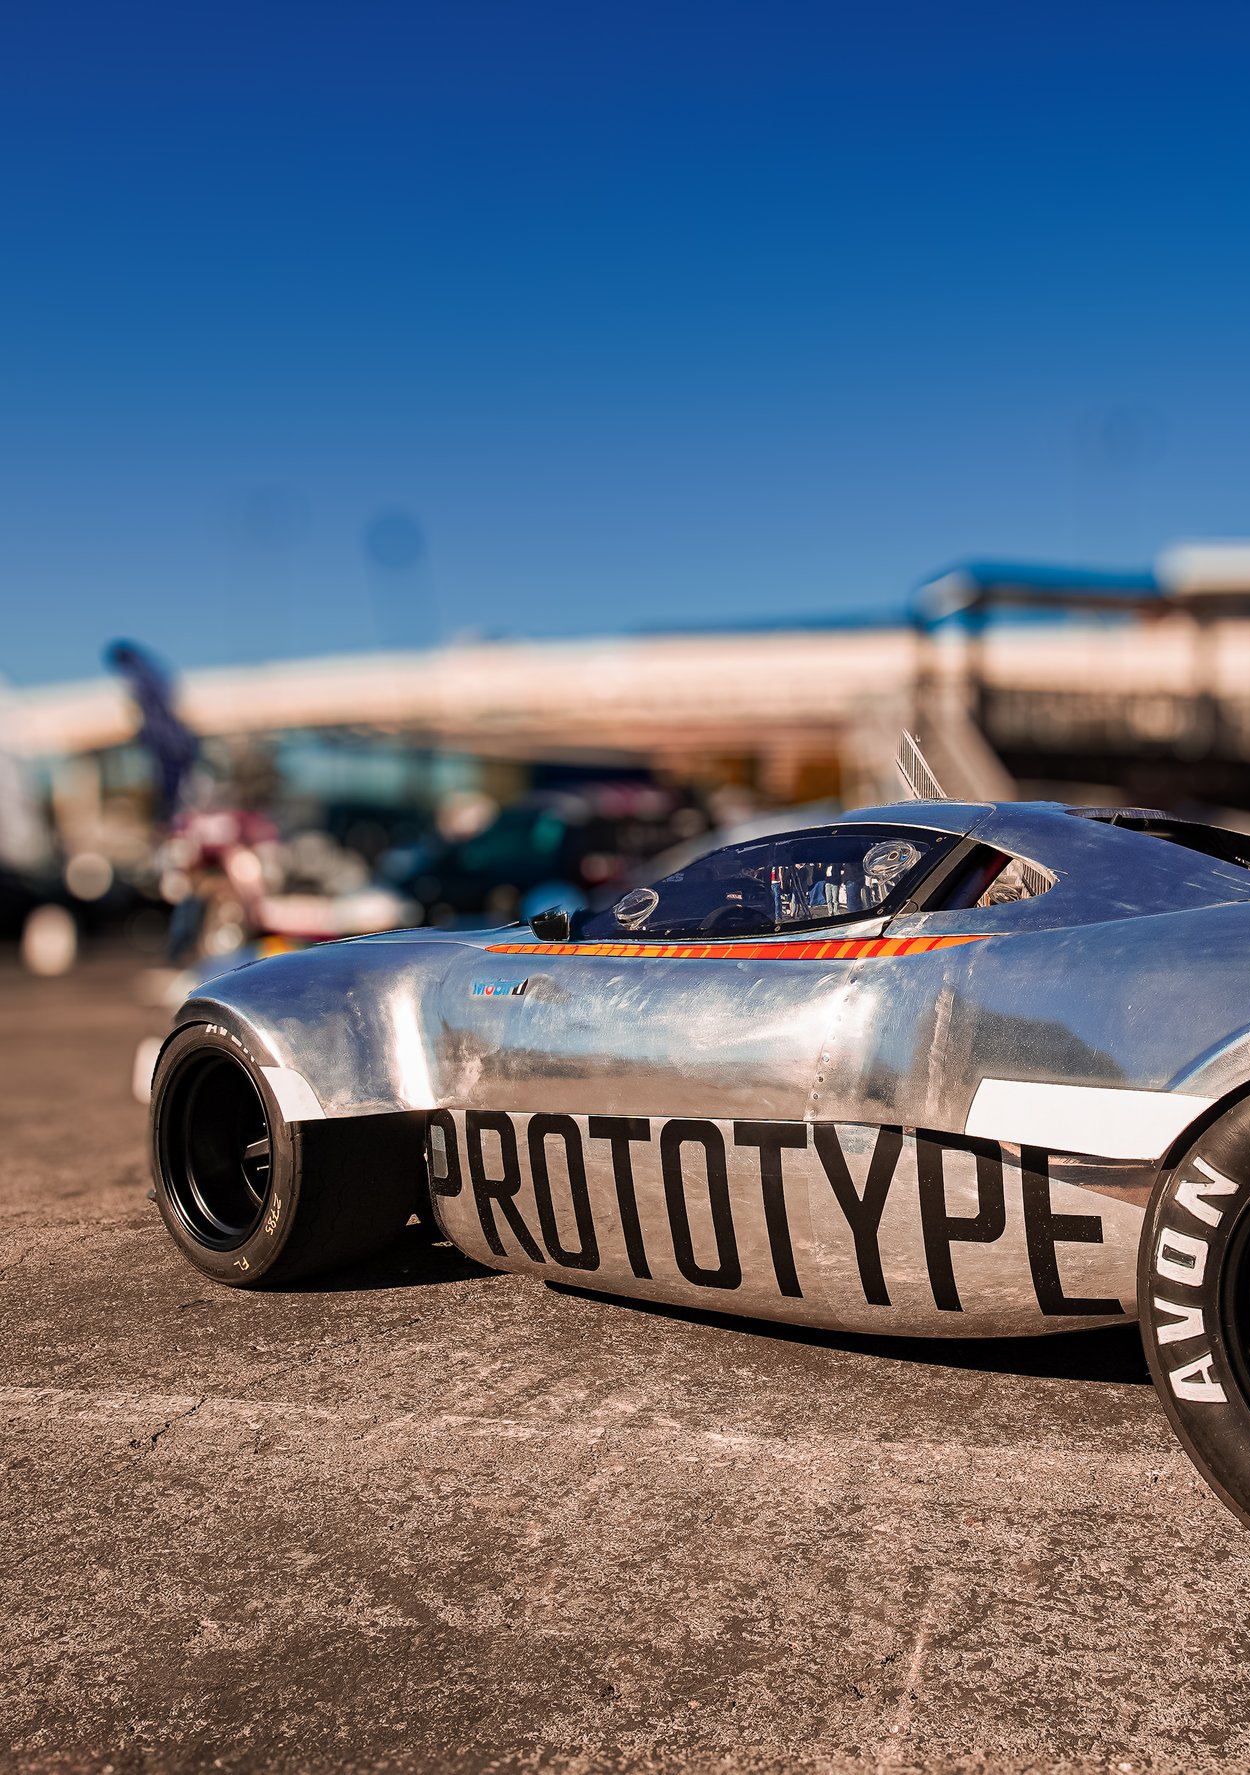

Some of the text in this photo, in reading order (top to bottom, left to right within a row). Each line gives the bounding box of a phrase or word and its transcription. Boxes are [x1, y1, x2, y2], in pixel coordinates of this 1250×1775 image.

[265, 1192, 282, 1236] 2785
[427, 1109, 1126, 1317] PROTOTYPE
[1153, 1156, 1241, 1403] AVON
